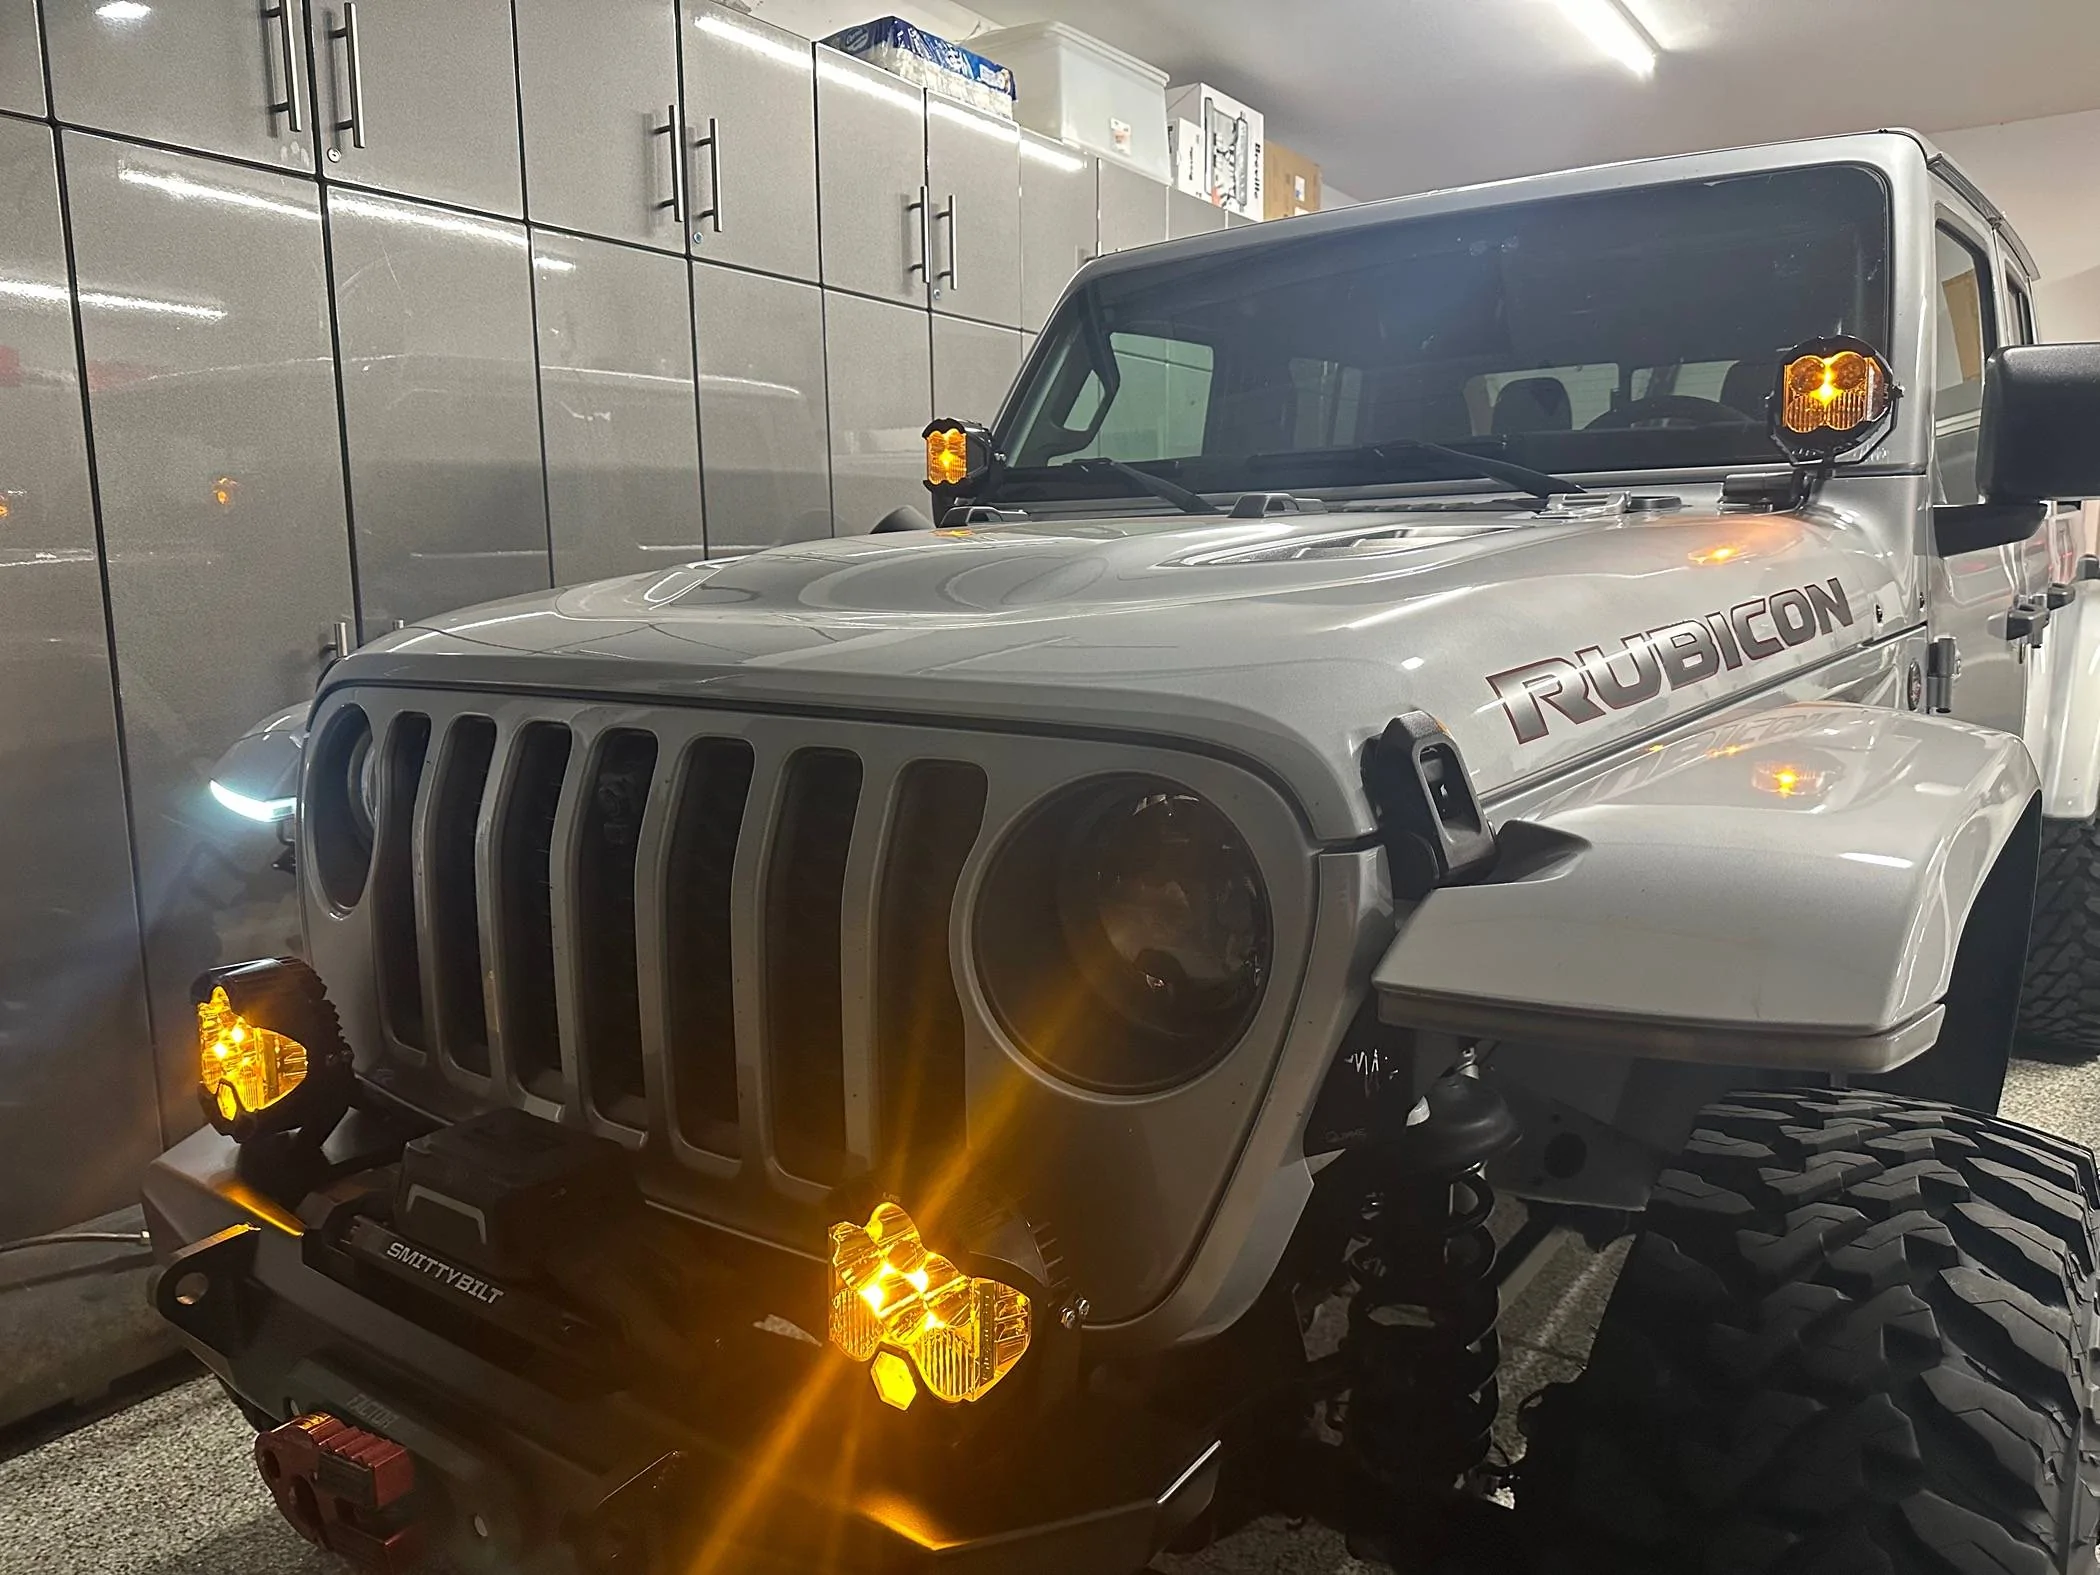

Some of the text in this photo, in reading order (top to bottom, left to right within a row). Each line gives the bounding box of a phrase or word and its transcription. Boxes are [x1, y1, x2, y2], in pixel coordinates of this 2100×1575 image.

[1254, 142, 1262, 199] Breville
[1486, 577, 1853, 744] RUBICON
[386, 1242, 504, 1304] SMITTYBILT
[346, 1392, 400, 1429] FACTOR
